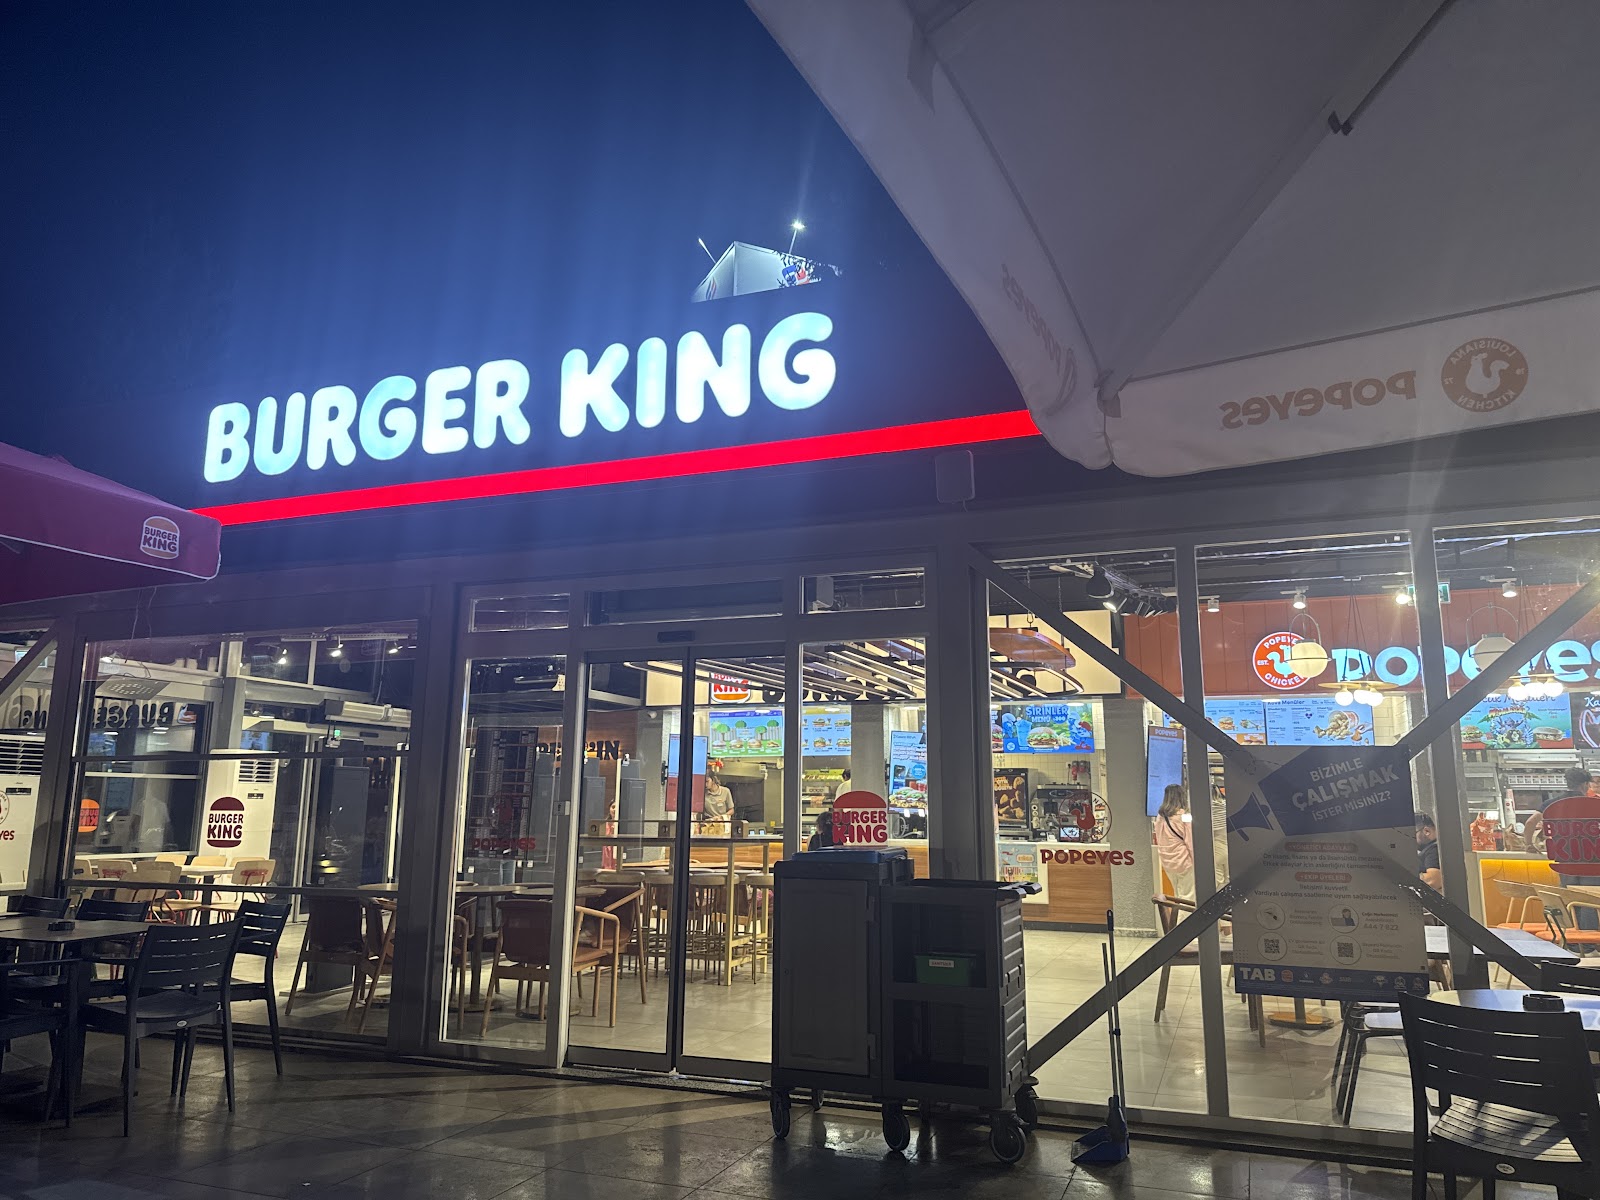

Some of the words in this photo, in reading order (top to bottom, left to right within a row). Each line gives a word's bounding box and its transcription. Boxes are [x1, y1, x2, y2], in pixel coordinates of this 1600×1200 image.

[203, 357, 531, 484] BURGER
[559, 311, 837, 439] KING
[144, 526, 178, 542] BURGER
[142, 535, 177, 552] KING
[1263, 635, 1299, 649] POPEYE
[1264, 673, 1305, 686] CHICKE
[1309, 757, 1363, 782] BİZİMLE
[1292, 764, 1400, 812] ÇALIŞMAK
[208, 813, 244, 824] BURGER
[832, 810, 888, 824] BURGER
[1312, 805, 1343, 822] İSTER
[207, 824, 243, 839] KING
[832, 824, 888, 844] KING
[1239, 966, 1276, 982] TAB
